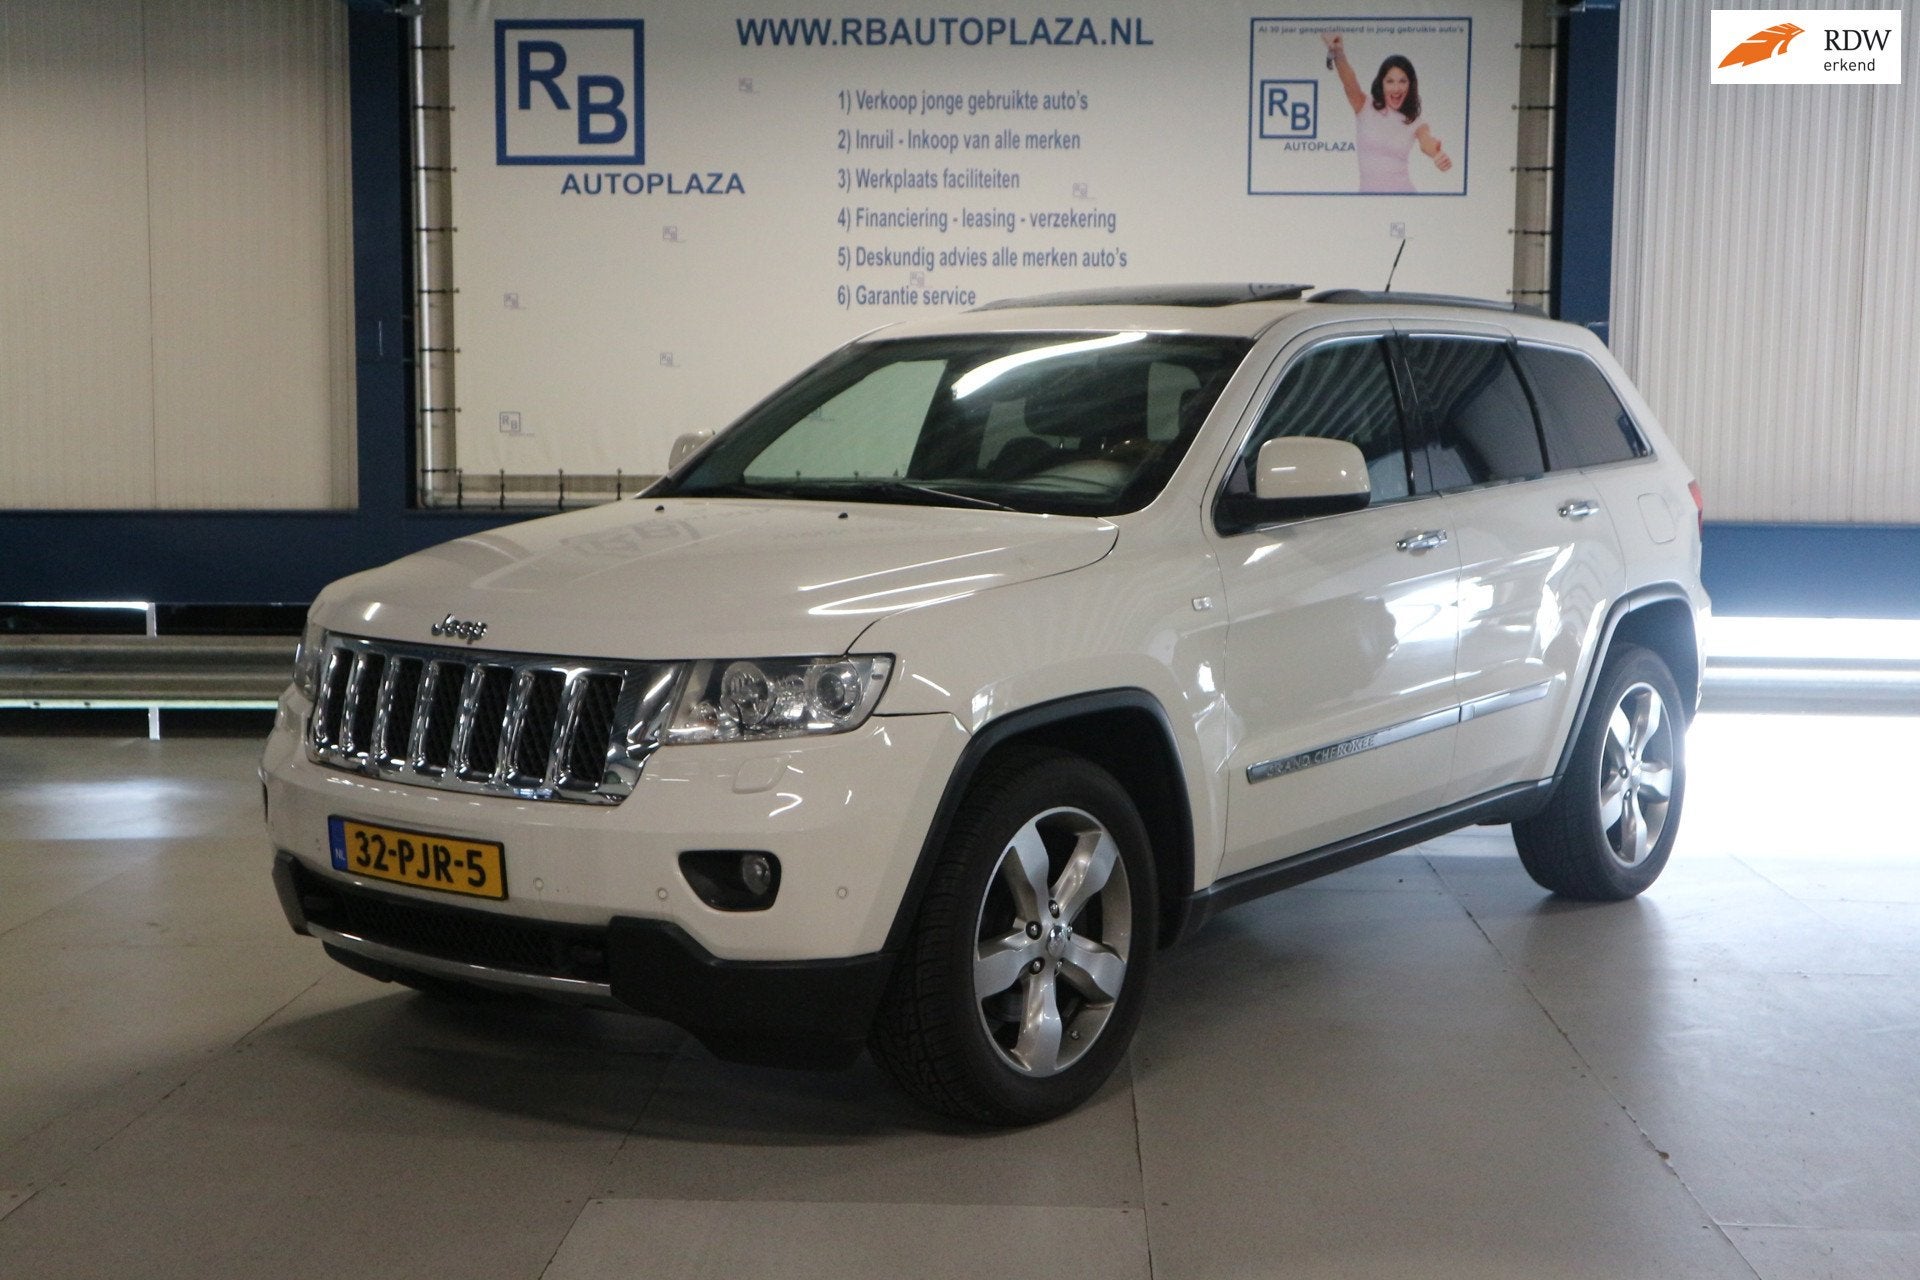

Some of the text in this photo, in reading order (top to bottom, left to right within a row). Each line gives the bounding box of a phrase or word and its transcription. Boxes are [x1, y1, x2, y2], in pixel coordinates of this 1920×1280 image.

[736, 17, 1154, 46] WWW.RBAUTOPLAZA.NL
[517, 40, 628, 145] RB
[838, 89, 1088, 115] 1) Verkoop jonge gebruikte auto's
[1268, 88, 1311, 131] RB
[838, 129, 851, 154] 2)
[856, 129, 894, 150] Inruil
[908, 129, 959, 154] Inkoop
[963, 134, 989, 149] van
[994, 129, 1020, 149] alle
[1025, 129, 1081, 149] merken
[1284, 141, 1355, 151] AUTOPLAZA
[560, 172, 746, 196] AUTOPLAZA
[838, 168, 1019, 193] 3) Werkplaats faciliteiten
[838, 208, 851, 232] 4)
[856, 208, 948, 232] Financiering
[962, 208, 1015, 232] leasing
[1030, 208, 1117, 232] verzekering
[838, 247, 1127, 271] 5) Deskundig advies alle merken auto's
[838, 286, 976, 309] 6) Garantie service
[431, 612, 488, 645] Jeep
[1267, 736, 1375, 777] GRAND CHEROKEE
[335, 848, 346, 861] NL
[354, 830, 486, 888] 32-PJR-5
